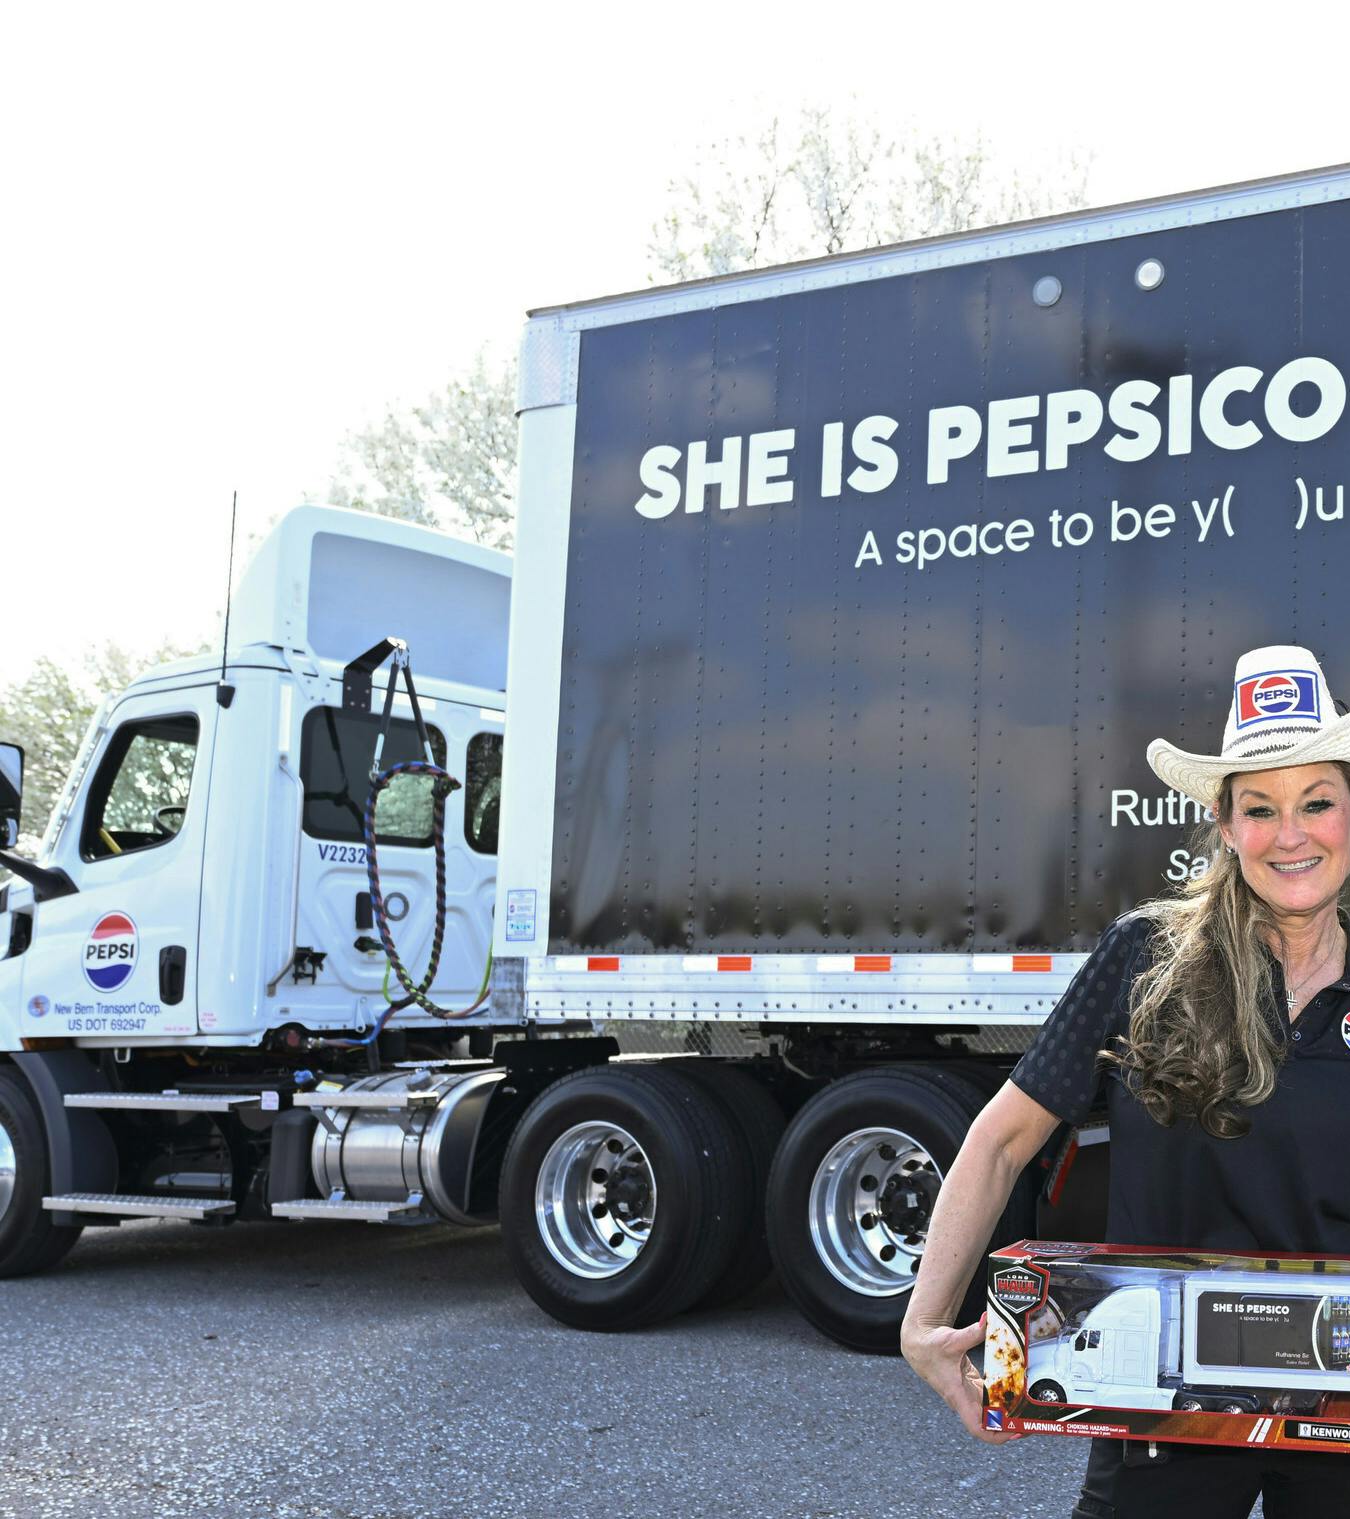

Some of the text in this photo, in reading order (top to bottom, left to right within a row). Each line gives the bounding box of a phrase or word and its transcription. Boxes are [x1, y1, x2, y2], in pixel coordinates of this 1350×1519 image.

[634, 356, 1347, 519] SHE IS PEPSICO
[854, 530, 883, 568] A
[895, 519, 1034, 569] space
[1049, 509, 1094, 548] to
[1111, 500, 1177, 542] be
[1254, 689, 1298, 702] PEPSI
[318, 844, 366, 864] V2232
[86, 943, 135, 960] PEPSI
[54, 1004, 71, 1015] New
[95, 1002, 137, 1015] Transport
[138, 1002, 162, 1015] Corp.
[68, 1018, 146, 1031] US DOT 692947
[997, 1279, 1038, 1294] HAUL
[1212, 1303, 1290, 1315] SHE IS PEPSICO
[1023, 1422, 1065, 1432] WARNING:
